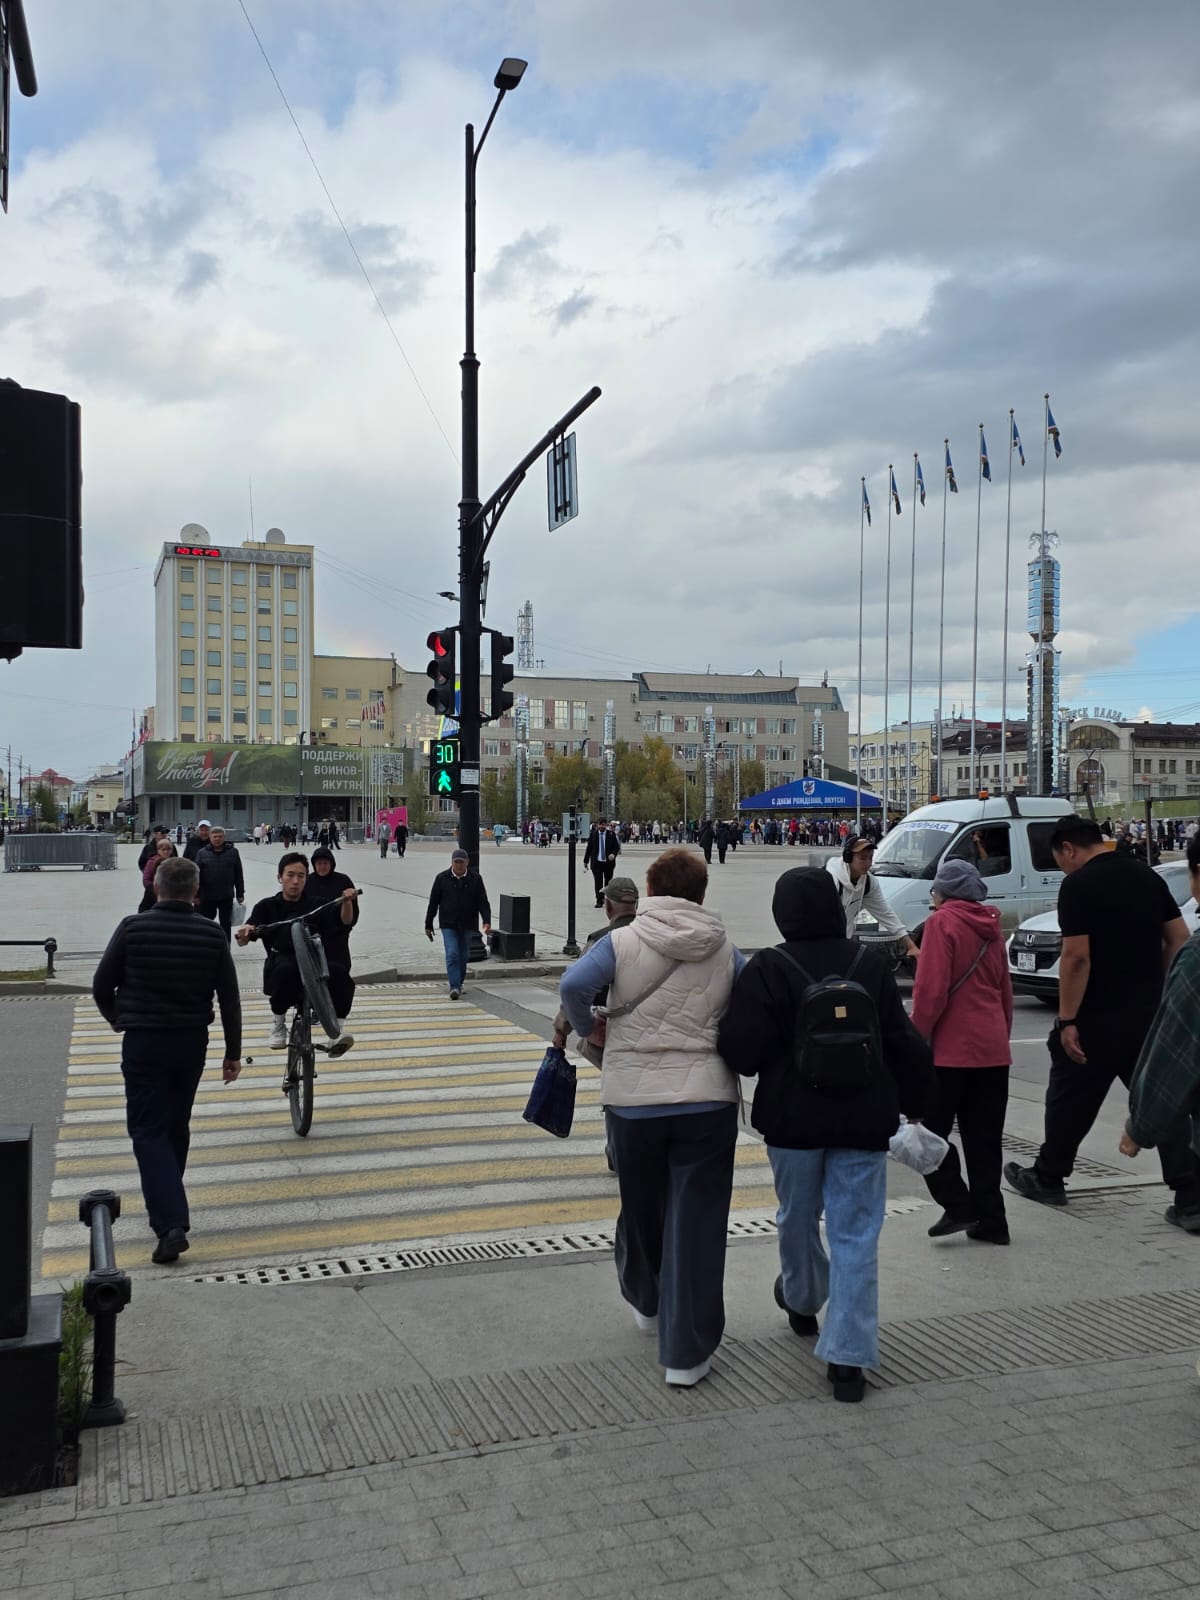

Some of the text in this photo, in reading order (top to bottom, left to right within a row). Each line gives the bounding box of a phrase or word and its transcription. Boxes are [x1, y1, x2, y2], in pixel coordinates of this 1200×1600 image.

[302, 750, 363, 762] ПОДДЕРЖИ
[437, 745, 453, 763] 30
[314, 765, 362, 775] ВОИНОВ-
[322, 780, 362, 790] ЯКУТЯН
